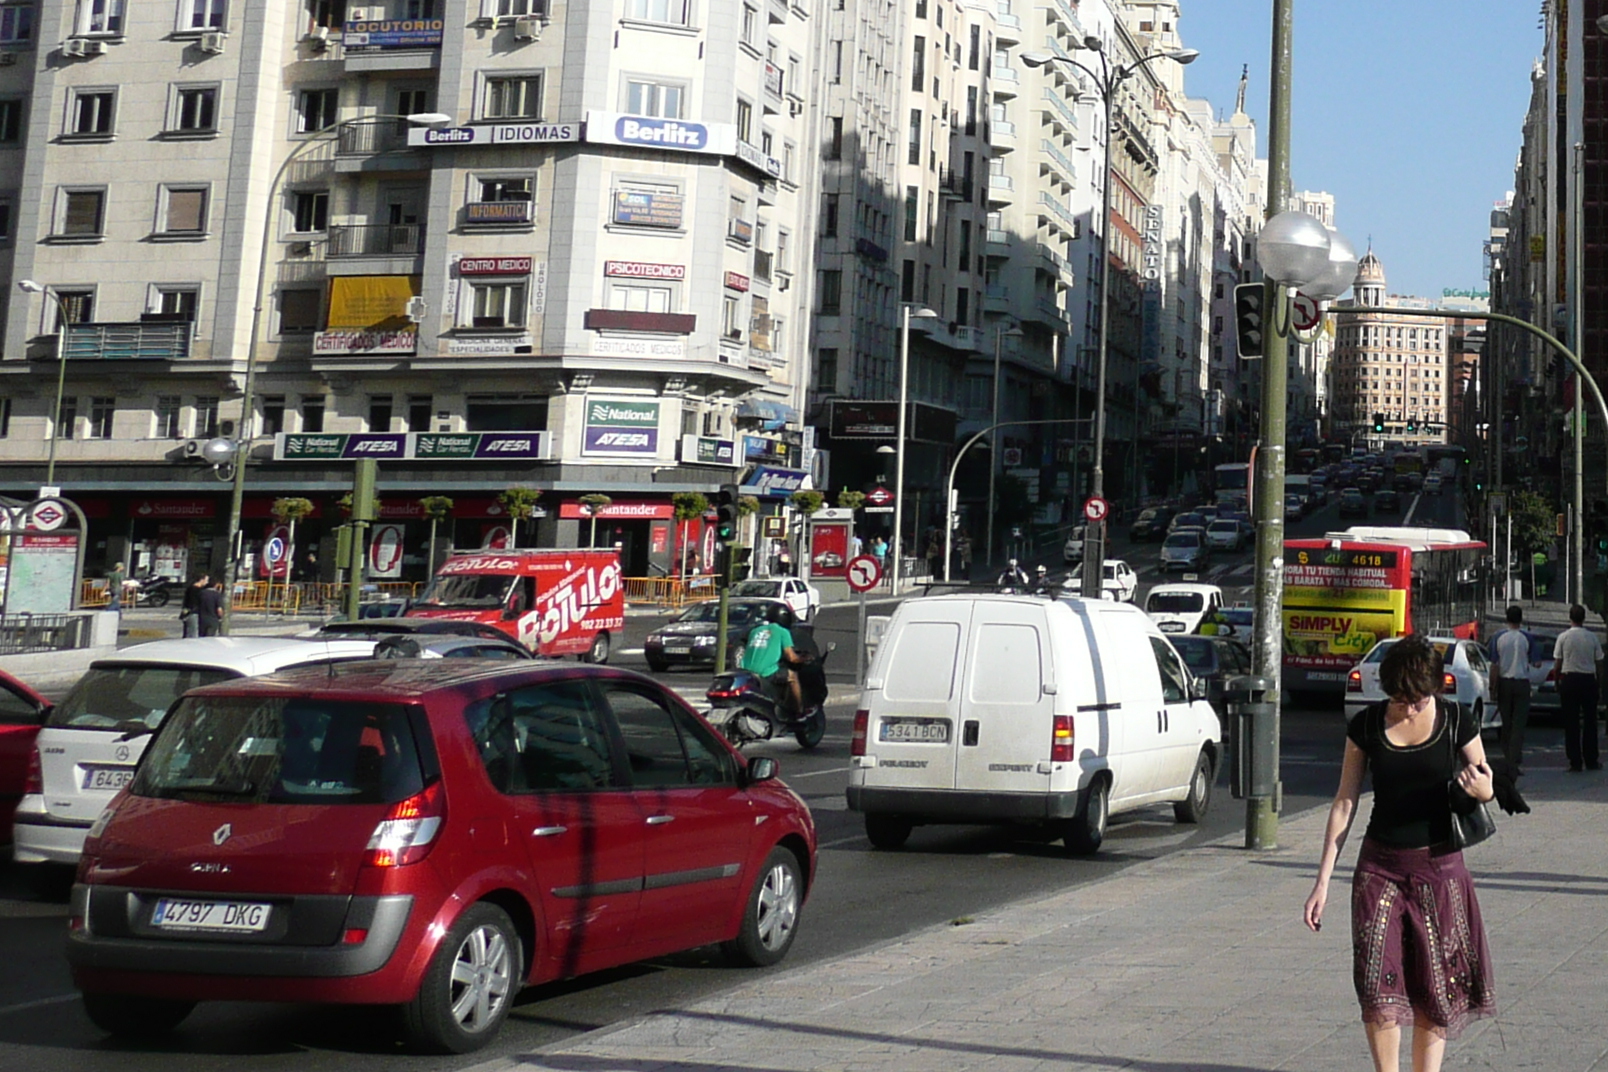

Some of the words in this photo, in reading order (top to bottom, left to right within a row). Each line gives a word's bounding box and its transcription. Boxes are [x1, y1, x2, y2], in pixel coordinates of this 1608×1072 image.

[346, 19, 443, 33] LOCUTORIO
[428, 129, 472, 142] Berlitz
[499, 125, 572, 142] IDIOMAS
[622, 121, 700, 147] Berlitz
[469, 202, 528, 220] INFORMATICA
[1143, 205, 1160, 292] SENATOR
[460, 259, 495, 271] CENTRO
[497, 259, 530, 271] MEDICO
[608, 262, 685, 278] PSICOTECNICO
[315, 332, 375, 351] CERTIFICADOS
[608, 407, 657, 422] National
[306, 437, 340, 447] National
[352, 440, 398, 453] ATESA
[437, 436, 472, 446] National
[485, 439, 532, 452] ATESA
[594, 432, 650, 448] ATESA
[153, 502, 207, 516] Santander
[1352, 555, 1382, 567] 4618
[1305, 566, 1316, 576] TU
[1318, 566, 1346, 577] TIENDA
[1347, 567, 1388, 578] HABITUAL
[1294, 576, 1325, 586] BARATA
[1333, 632, 1374, 652] City
[888, 726, 918, 738] 5341
[922, 726, 946, 739] BCN
[879, 759, 929, 769] PEUGEOT
[988, 763, 1034, 772] EXPERT
[164, 901, 215, 924] 4797
[223, 904, 263, 927] DKG
